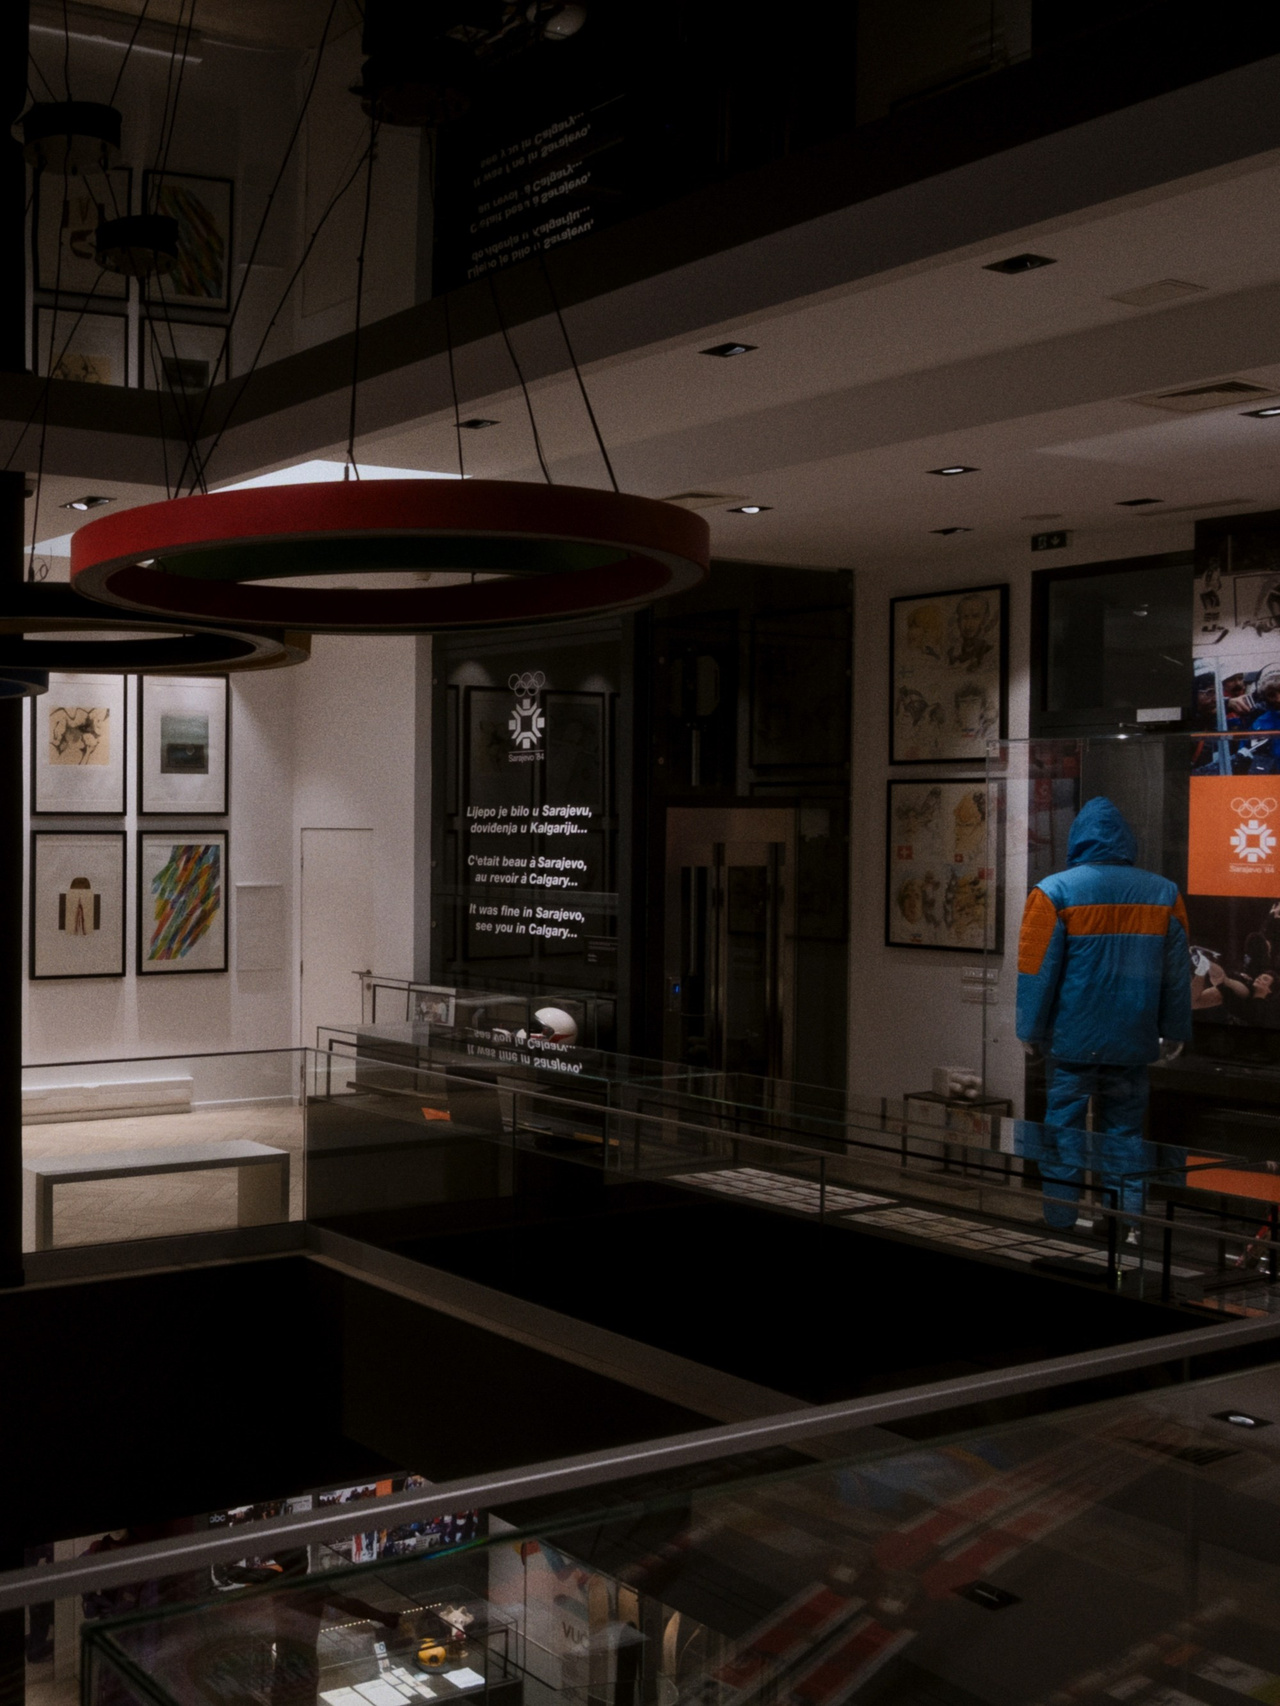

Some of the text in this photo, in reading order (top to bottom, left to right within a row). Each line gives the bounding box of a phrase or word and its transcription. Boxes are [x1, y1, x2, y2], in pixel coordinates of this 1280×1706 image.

[508, 753, 535, 763] Sarajevo
[466, 804, 593, 819] Lijepo je bilo u Sarajevu,
[520, 824, 527, 833] u
[530, 821, 588, 836] Kalgariju...
[467, 854, 588, 872] C'etait beau à Sarajevo,
[475, 872, 578, 888] au revoir à Calgary...
[469, 903, 586, 923] It was fine in Sarajevo,
[475, 922, 578, 940] see you in Calgary...
